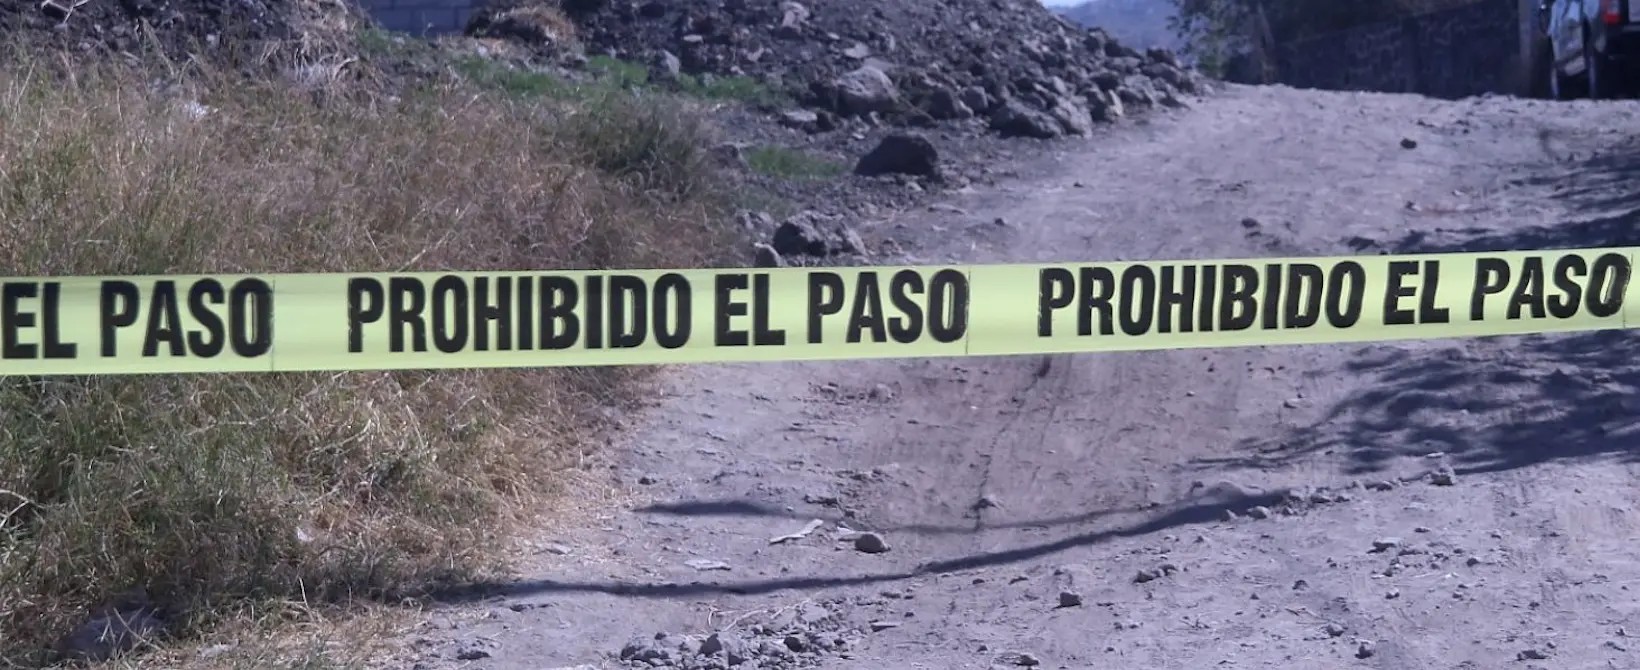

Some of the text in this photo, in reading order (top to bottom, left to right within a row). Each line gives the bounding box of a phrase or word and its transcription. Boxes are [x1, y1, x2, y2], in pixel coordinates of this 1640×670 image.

[2, 277, 274, 359] EL PASO
[347, 269, 969, 354] PROHIBIDO EL PASO
[1038, 252, 1632, 337] PROHIBIDO EL PASO
